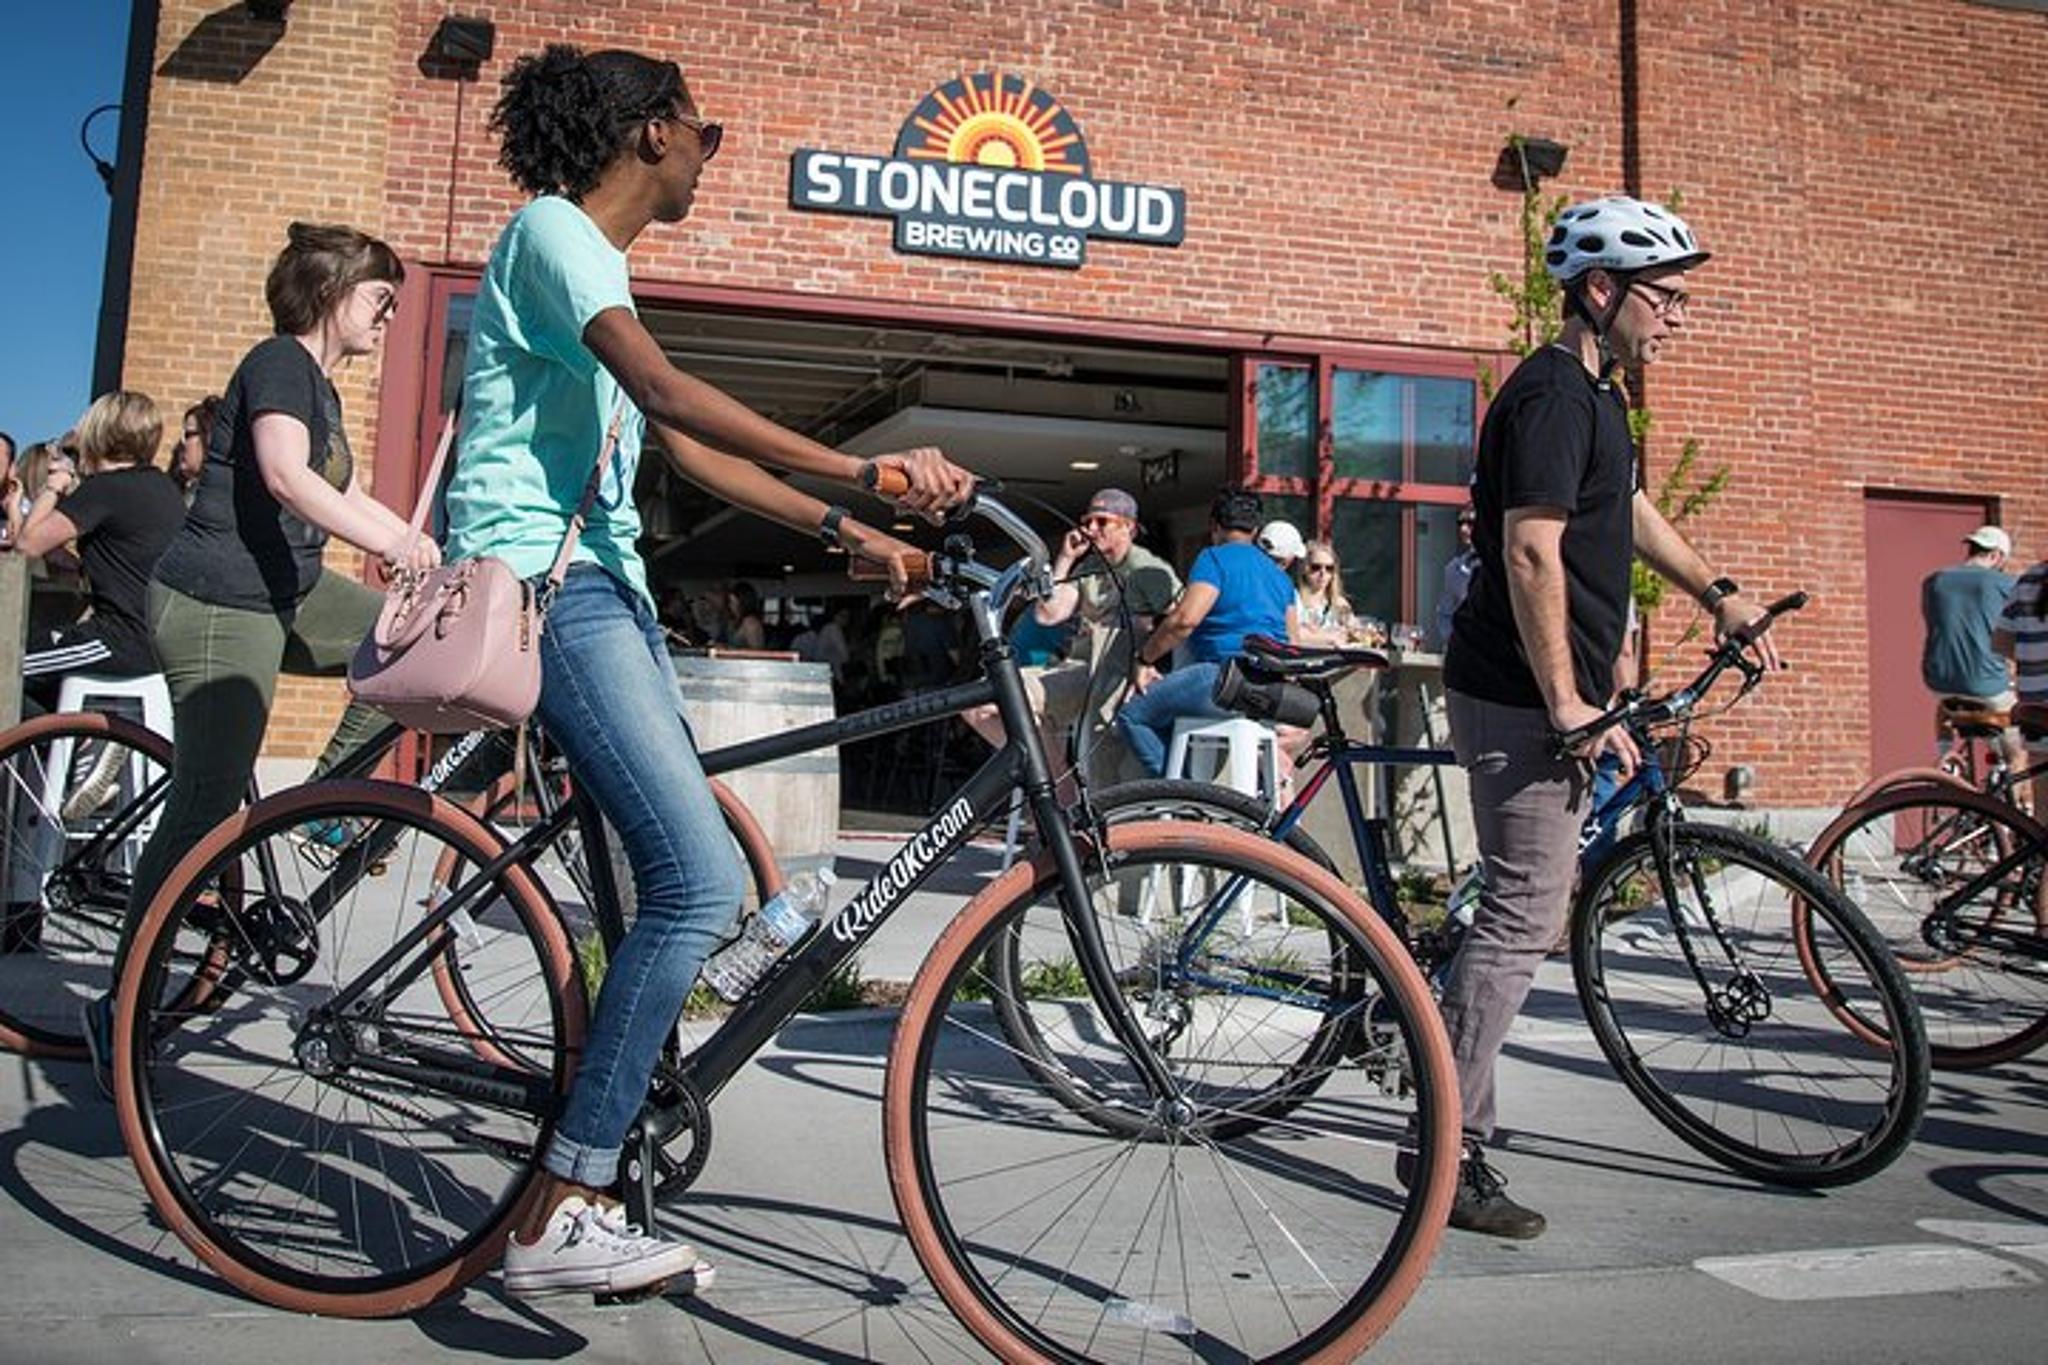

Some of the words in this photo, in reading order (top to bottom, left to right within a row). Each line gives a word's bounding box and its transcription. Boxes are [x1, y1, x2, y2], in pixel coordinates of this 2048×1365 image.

[806, 154, 1173, 236] STONECLOUD
[905, 221, 1045, 258] BREWING
[832, 797, 974, 942] RideOKC.com
